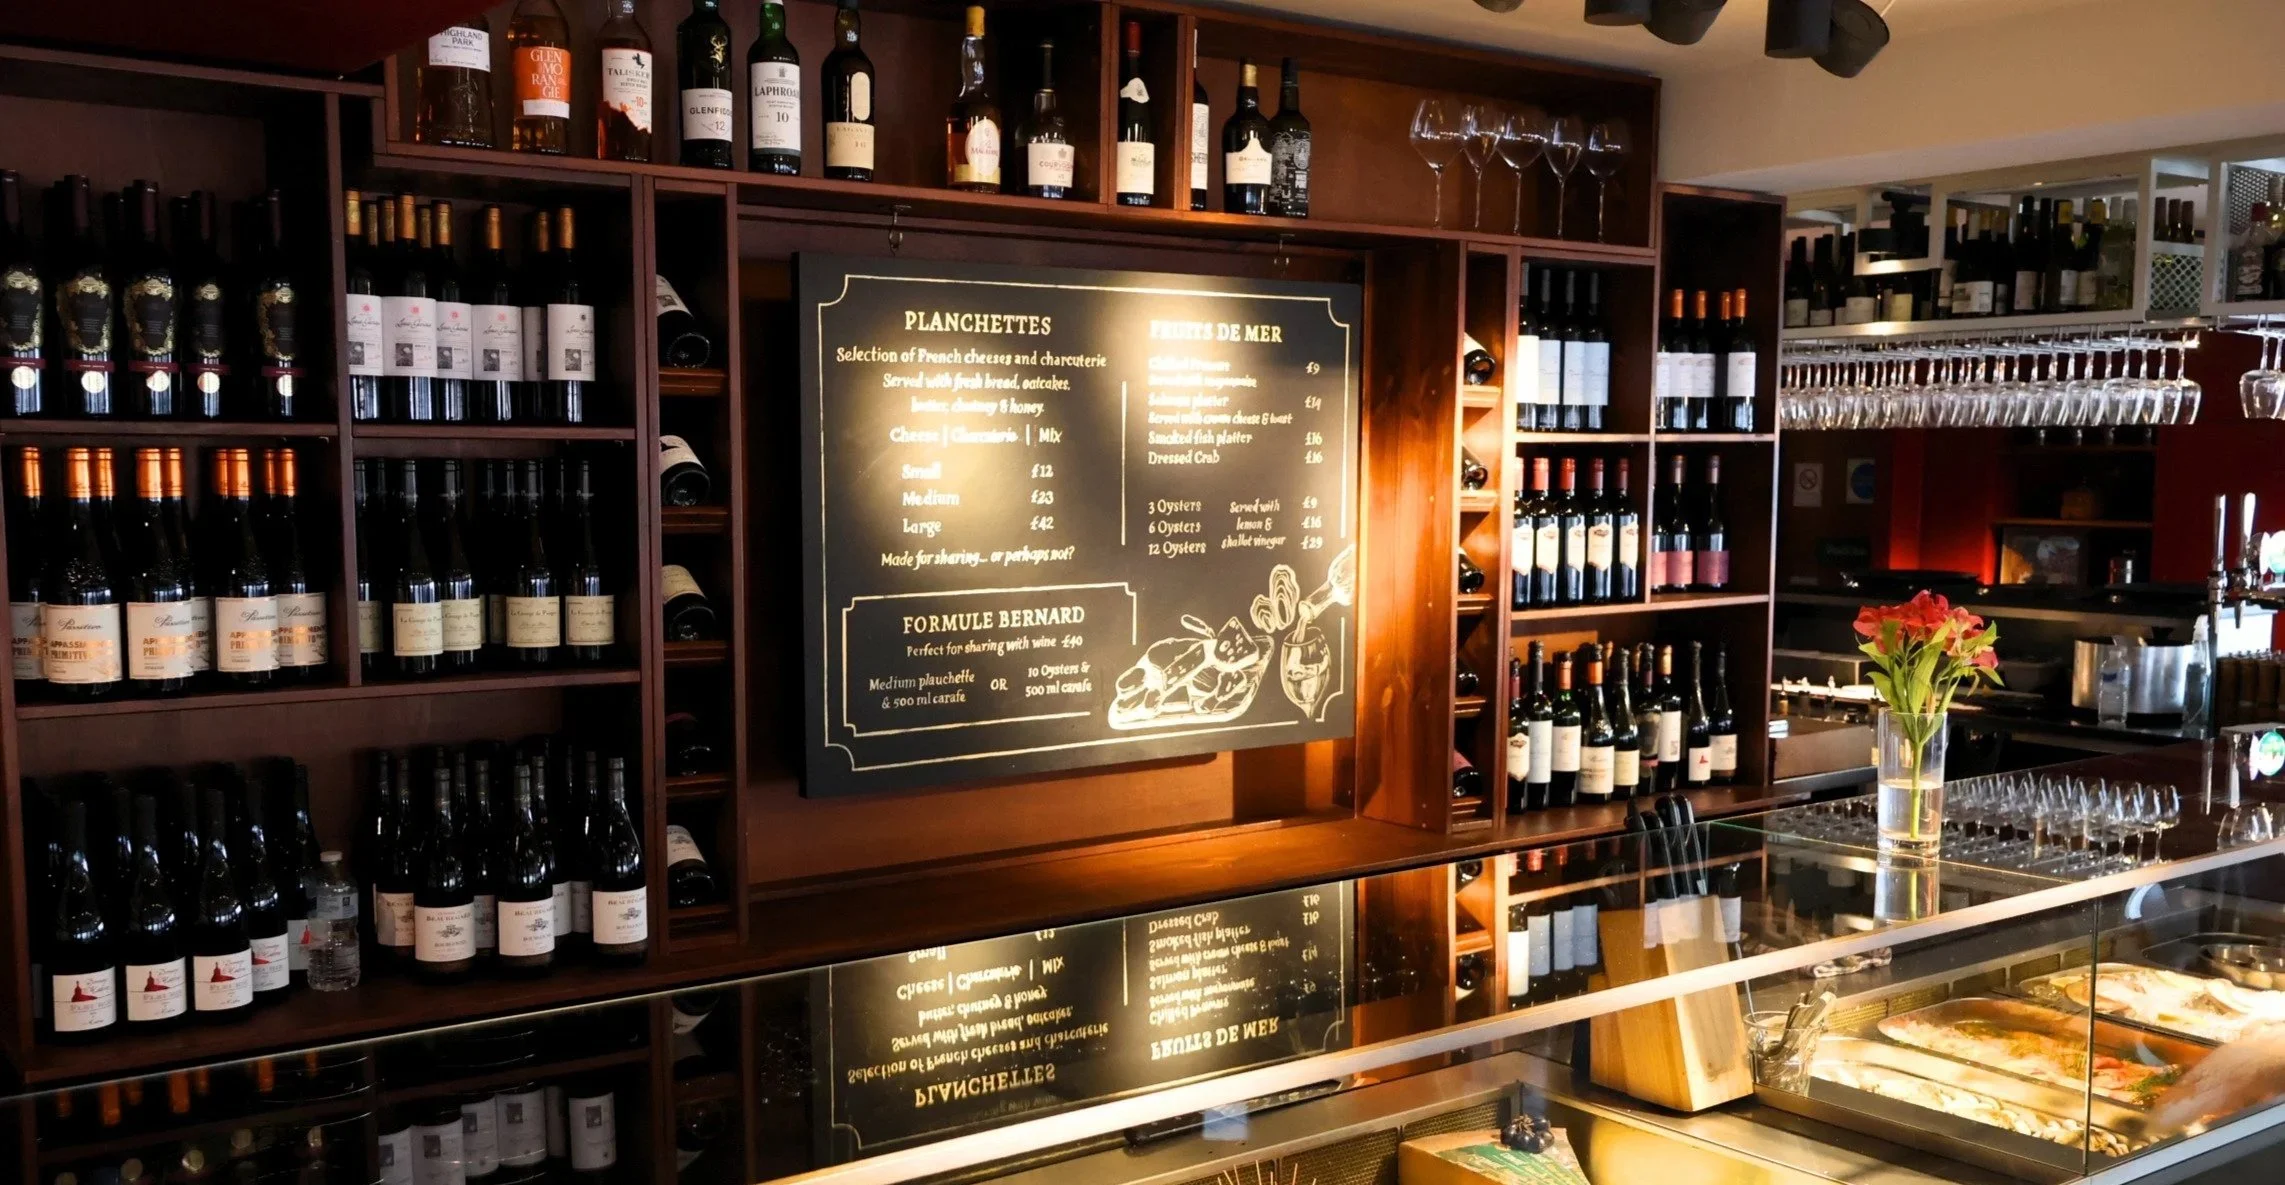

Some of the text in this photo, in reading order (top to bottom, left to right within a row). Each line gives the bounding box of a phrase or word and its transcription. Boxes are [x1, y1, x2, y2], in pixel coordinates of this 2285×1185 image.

[452, 37, 474, 47] PARK
[530, 49, 562, 63] GLEN
[542, 62, 563, 76] MO
[532, 73, 557, 86] RAN
[542, 86, 561, 99] GIE
[777, 111, 789, 123] 10
[715, 121, 726, 131] 12
[905, 310, 1051, 335] PLANCHETTES
[1216, 323, 1241, 342] DE
[1244, 324, 1283, 343] MER
[836, 346, 1107, 368] Selection of French cheeses and charcuterie
[1305, 361, 1321, 375] £9
[883, 371, 924, 389] Served
[926, 373, 951, 389] with
[1000, 398, 1009, 414] &
[1232, 410, 1260, 425] cheese
[1261, 412, 1270, 426] &
[890, 425, 940, 444] Cheese
[1148, 429, 1253, 447] Smoked fish platter
[1304, 431, 1323, 446] £16
[1148, 449, 1220, 465] Dressed Crab
[1304, 450, 1323, 464] £16
[901, 461, 942, 480] Small
[1031, 464, 1054, 479] £12
[902, 488, 961, 507] Medium
[1031, 490, 1054, 505] £23
[1302, 496, 1318, 509] £9
[1148, 499, 1202, 516] 3 Oysters
[1229, 498, 1280, 514] Served with
[902, 518, 942, 538] Large
[1030, 516, 1054, 531] £42
[1148, 520, 1202, 537] 6 Oysters
[1236, 517, 1272, 532] lemon &
[1301, 516, 1322, 529] £16
[1221, 534, 1287, 549] shallot vinegar
[1300, 536, 1323, 550] £29
[881, 550, 913, 567] Made
[913, 549, 933, 571] for
[990, 550, 1004, 563] or
[1004, 545, 1049, 567] perhaps
[1050, 545, 1076, 561] not?
[1148, 541, 1207, 559] 12 Oysters
[903, 605, 1085, 634] FORMULE BERNARD
[906, 634, 1084, 657] Perfect for sharing with wine £40
[1027, 661, 1091, 680] 10 Oysters &
[869, 676, 916, 692] Medium
[990, 678, 1009, 691] OR
[1025, 678, 1093, 698] 500 ml carafe
[881, 690, 967, 710] & 500 ml carafe
